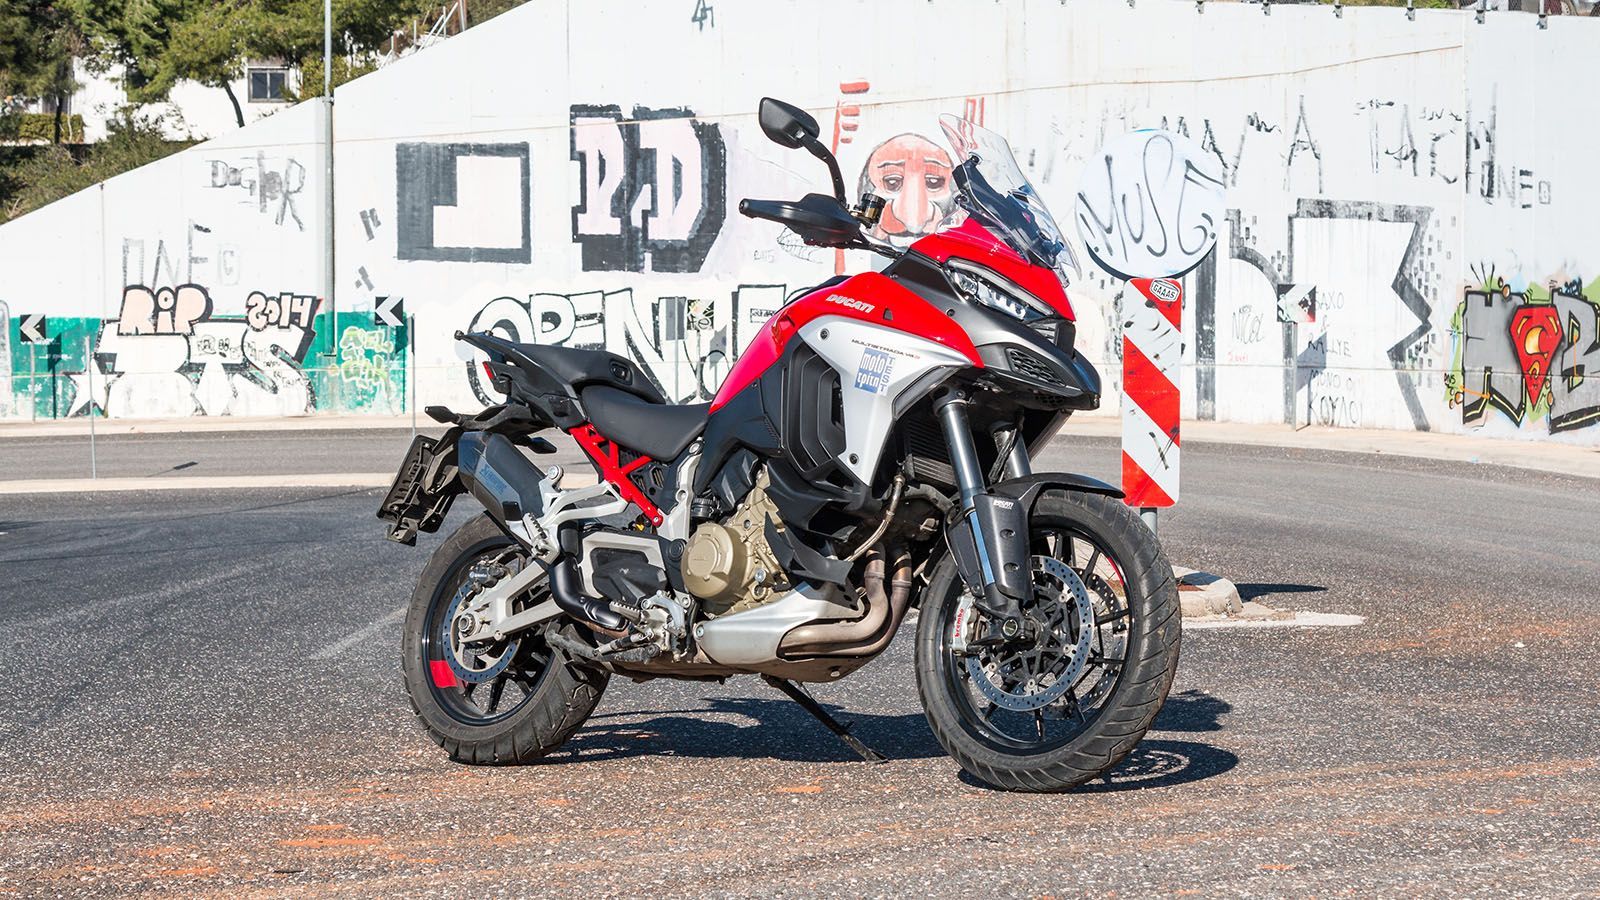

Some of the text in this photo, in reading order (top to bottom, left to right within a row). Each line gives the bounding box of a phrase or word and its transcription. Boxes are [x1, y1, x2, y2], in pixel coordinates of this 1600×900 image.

[826, 294, 876, 313] DUCATI
[860, 353, 886, 374] moto
[880, 356, 896, 392] TEST
